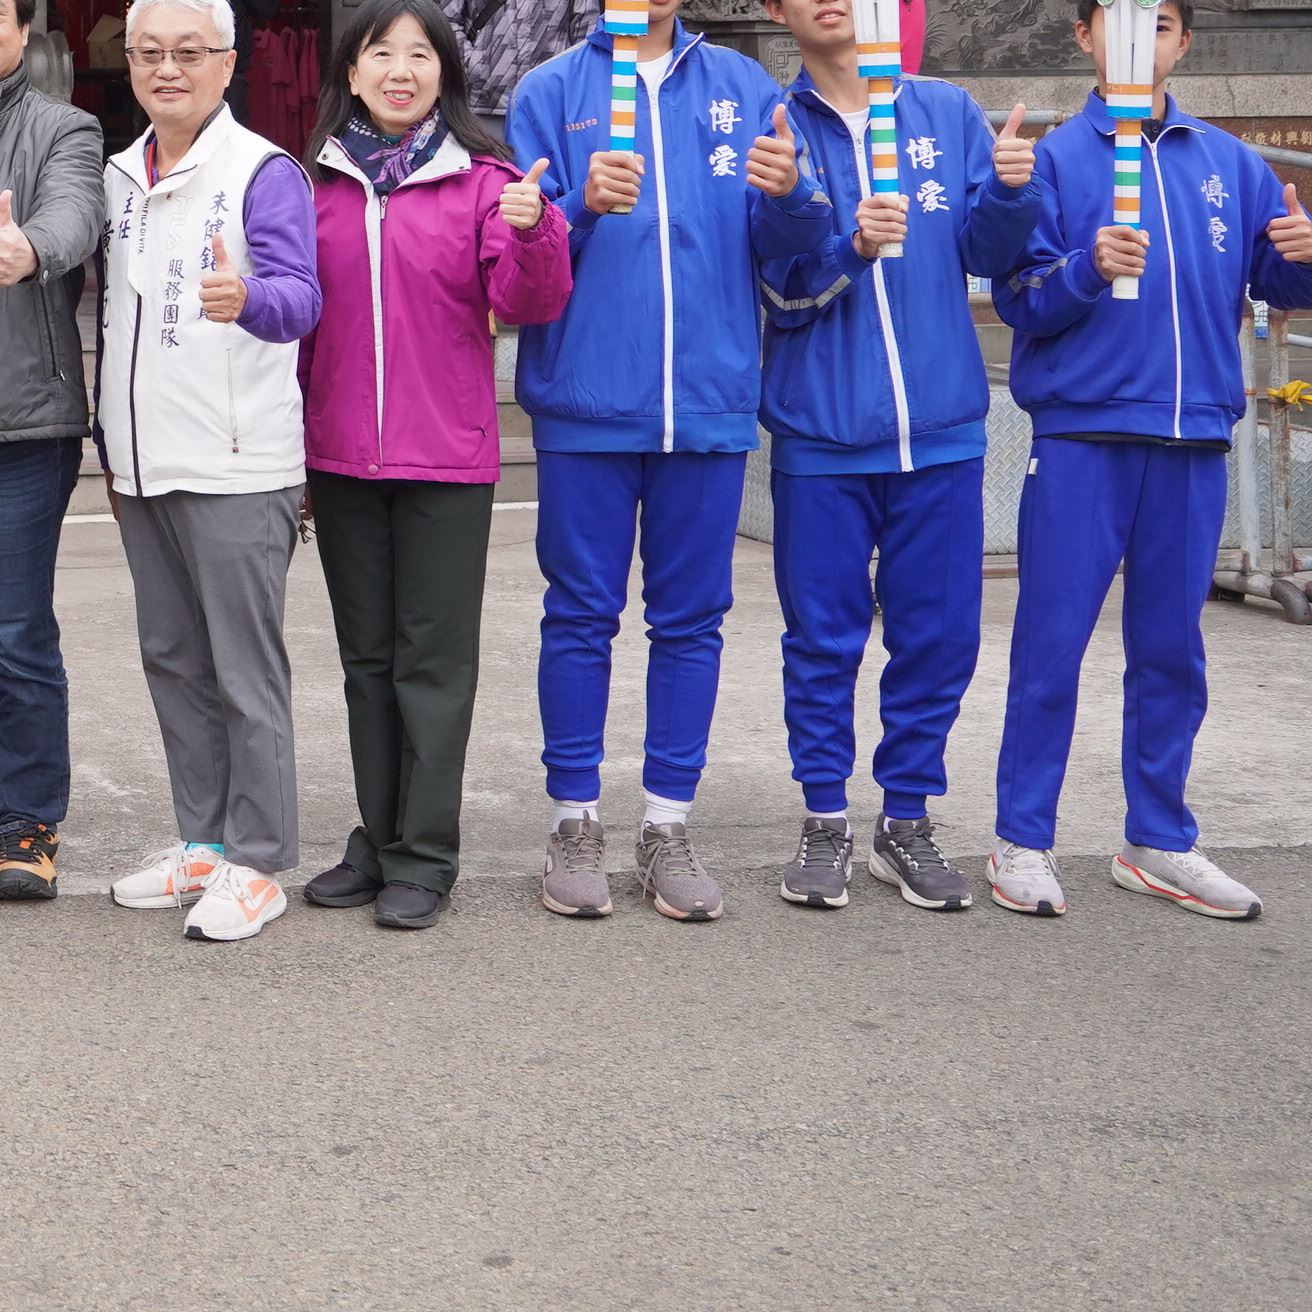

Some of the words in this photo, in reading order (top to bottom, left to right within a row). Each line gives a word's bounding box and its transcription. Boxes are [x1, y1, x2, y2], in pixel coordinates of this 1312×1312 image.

[708, 99, 743, 177] 博愛
[905, 136, 950, 213] 博愛
[118, 191, 134, 240] 主任
[160, 258, 185, 348] 服務團隊
